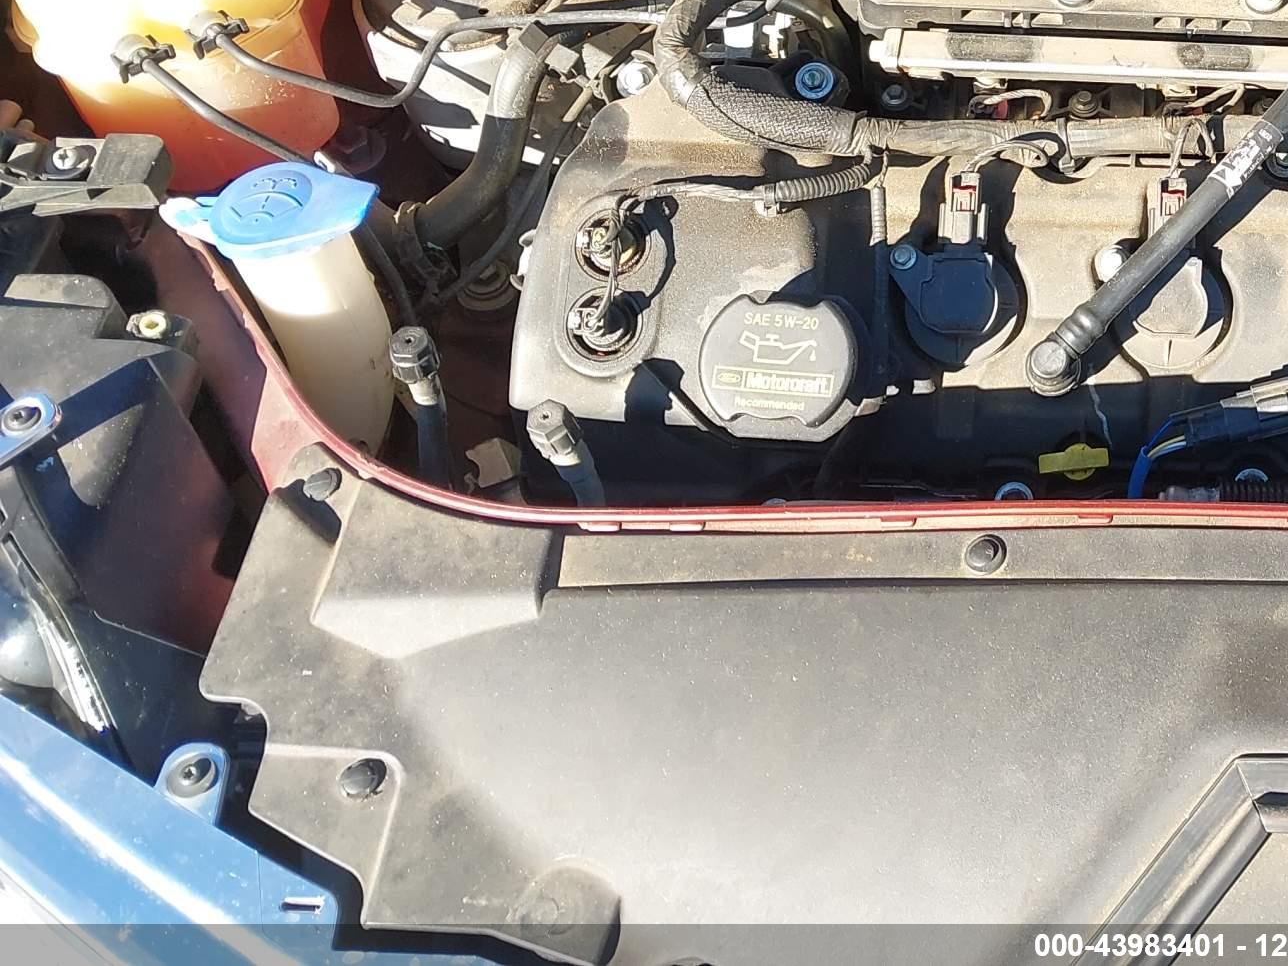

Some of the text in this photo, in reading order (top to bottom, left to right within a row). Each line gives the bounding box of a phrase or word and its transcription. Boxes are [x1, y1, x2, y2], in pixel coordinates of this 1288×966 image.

[744, 312, 820, 330] SAE 5W-20
[746, 371, 830, 394] Motorcraft
[734, 396, 806, 411] Recommended
